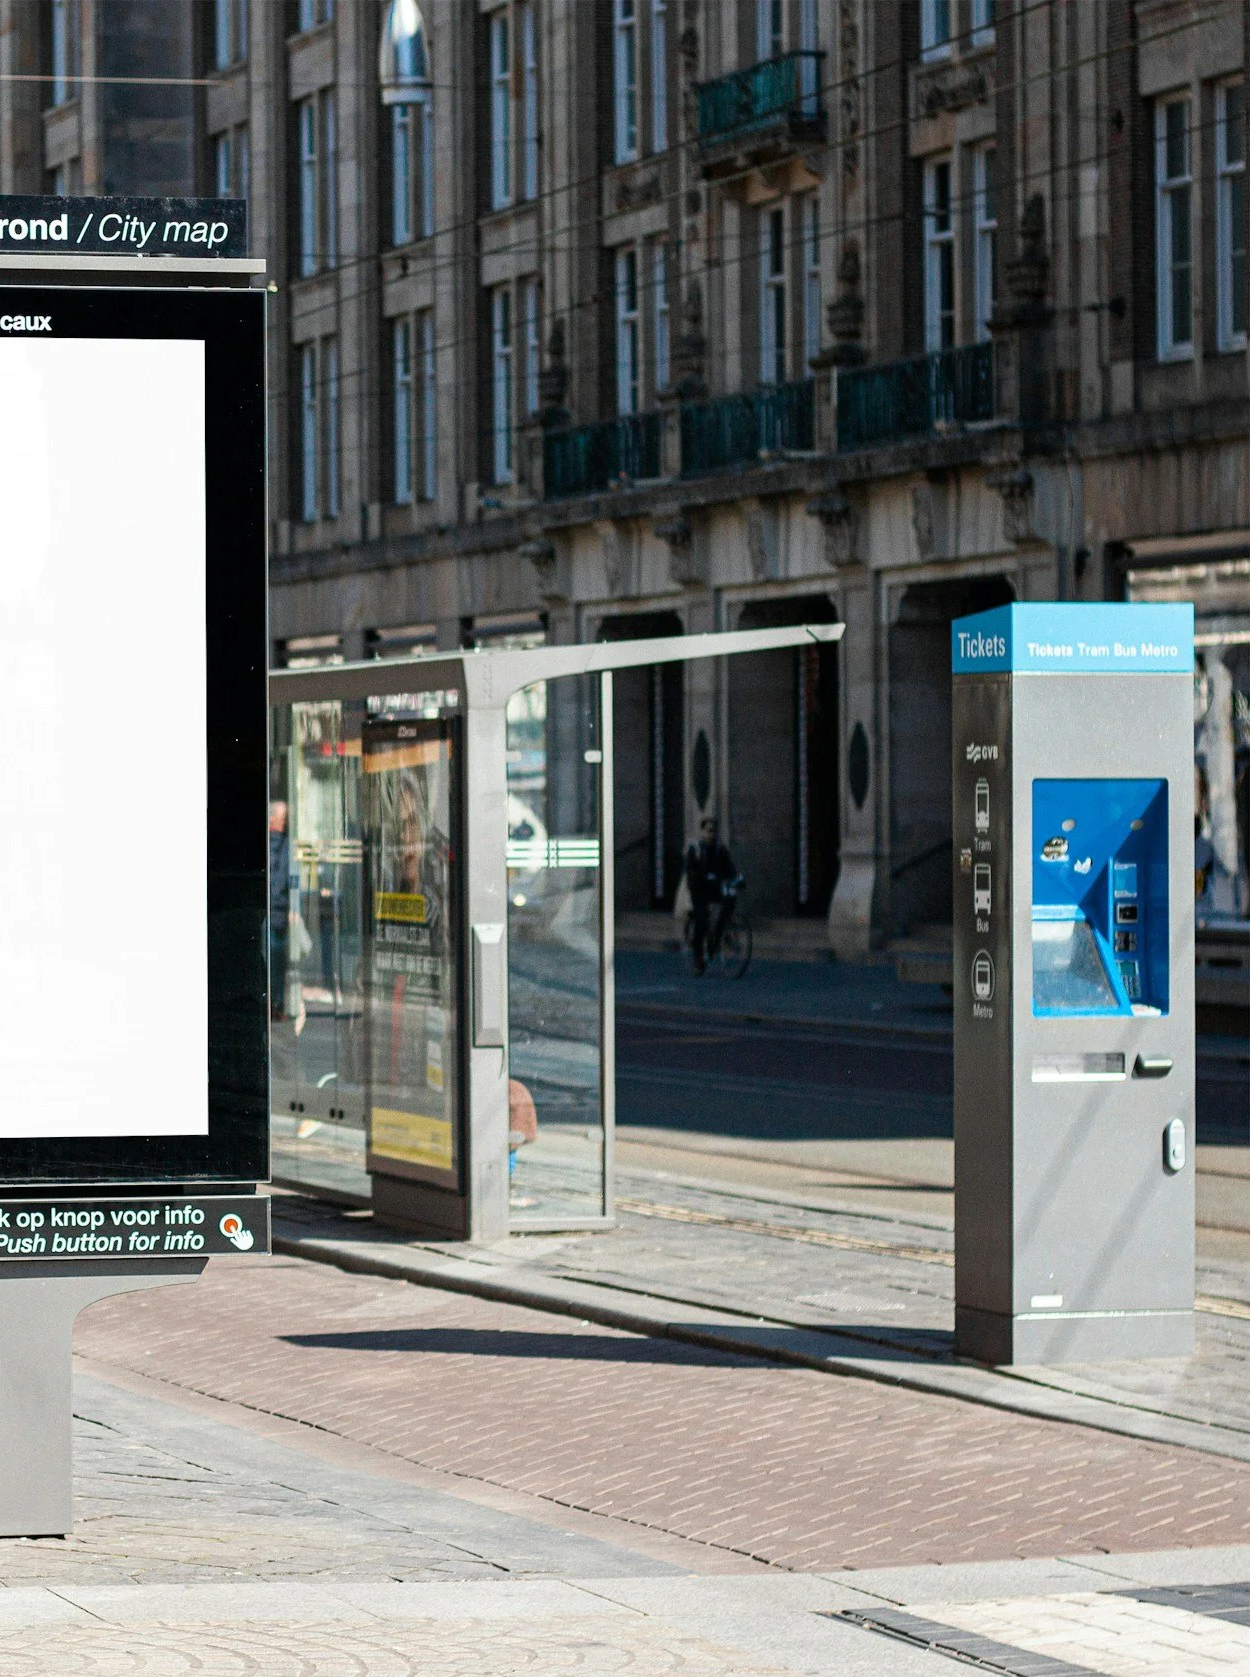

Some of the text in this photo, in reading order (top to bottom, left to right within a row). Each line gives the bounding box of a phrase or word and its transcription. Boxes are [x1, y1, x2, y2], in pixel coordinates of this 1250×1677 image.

[76, 213, 94, 244] /
[97, 213, 158, 247] City
[162, 221, 230, 248] map
[958, 631, 1006, 658] Tickets
[1027, 642, 1179, 658] Tickets Tram Bus Metro
[981, 745, 999, 760] GVB
[974, 836, 992, 852] Tram
[976, 918, 990, 933] Bus
[973, 1003, 994, 1019] Metro
[15, 1211, 45, 1232] op
[50, 1206, 105, 1231] knop
[110, 1208, 160, 1226] voor
[164, 1204, 205, 1225] info
[51, 1232, 123, 1253] button
[128, 1231, 161, 1252] for
[163, 1230, 205, 1251] info
